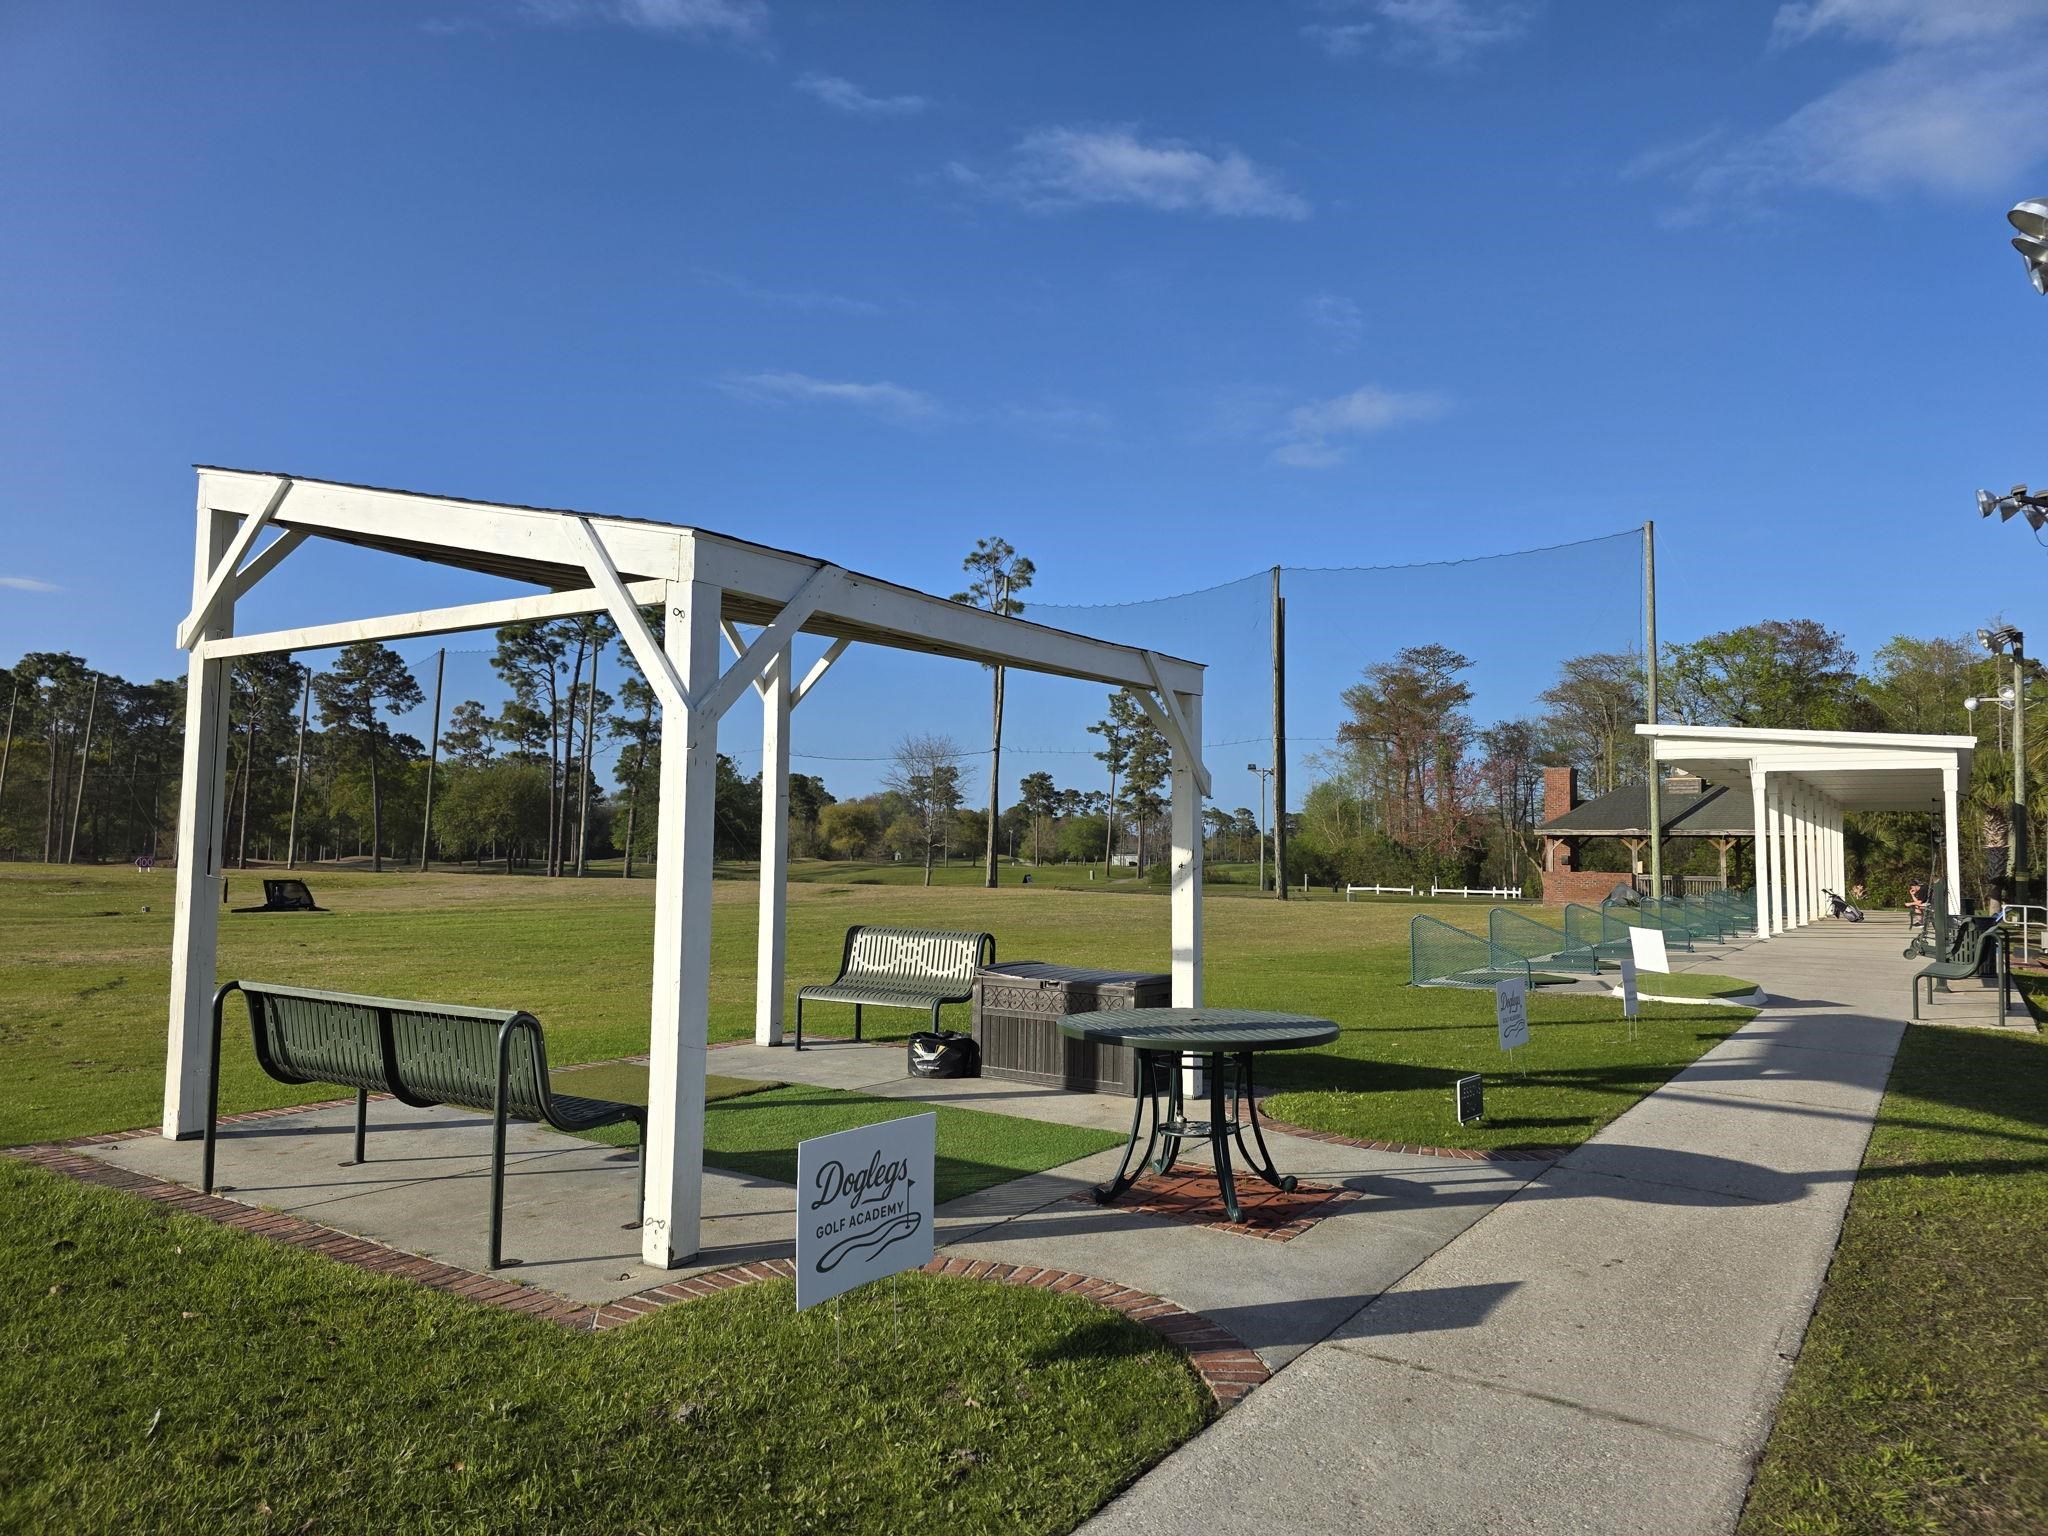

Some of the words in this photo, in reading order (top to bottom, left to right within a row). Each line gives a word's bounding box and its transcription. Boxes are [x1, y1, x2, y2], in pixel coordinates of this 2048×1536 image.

[811, 1150, 907, 1210] Doglegs
[816, 1218, 846, 1239] GOLF
[849, 1200, 904, 1228] ACADEMY
